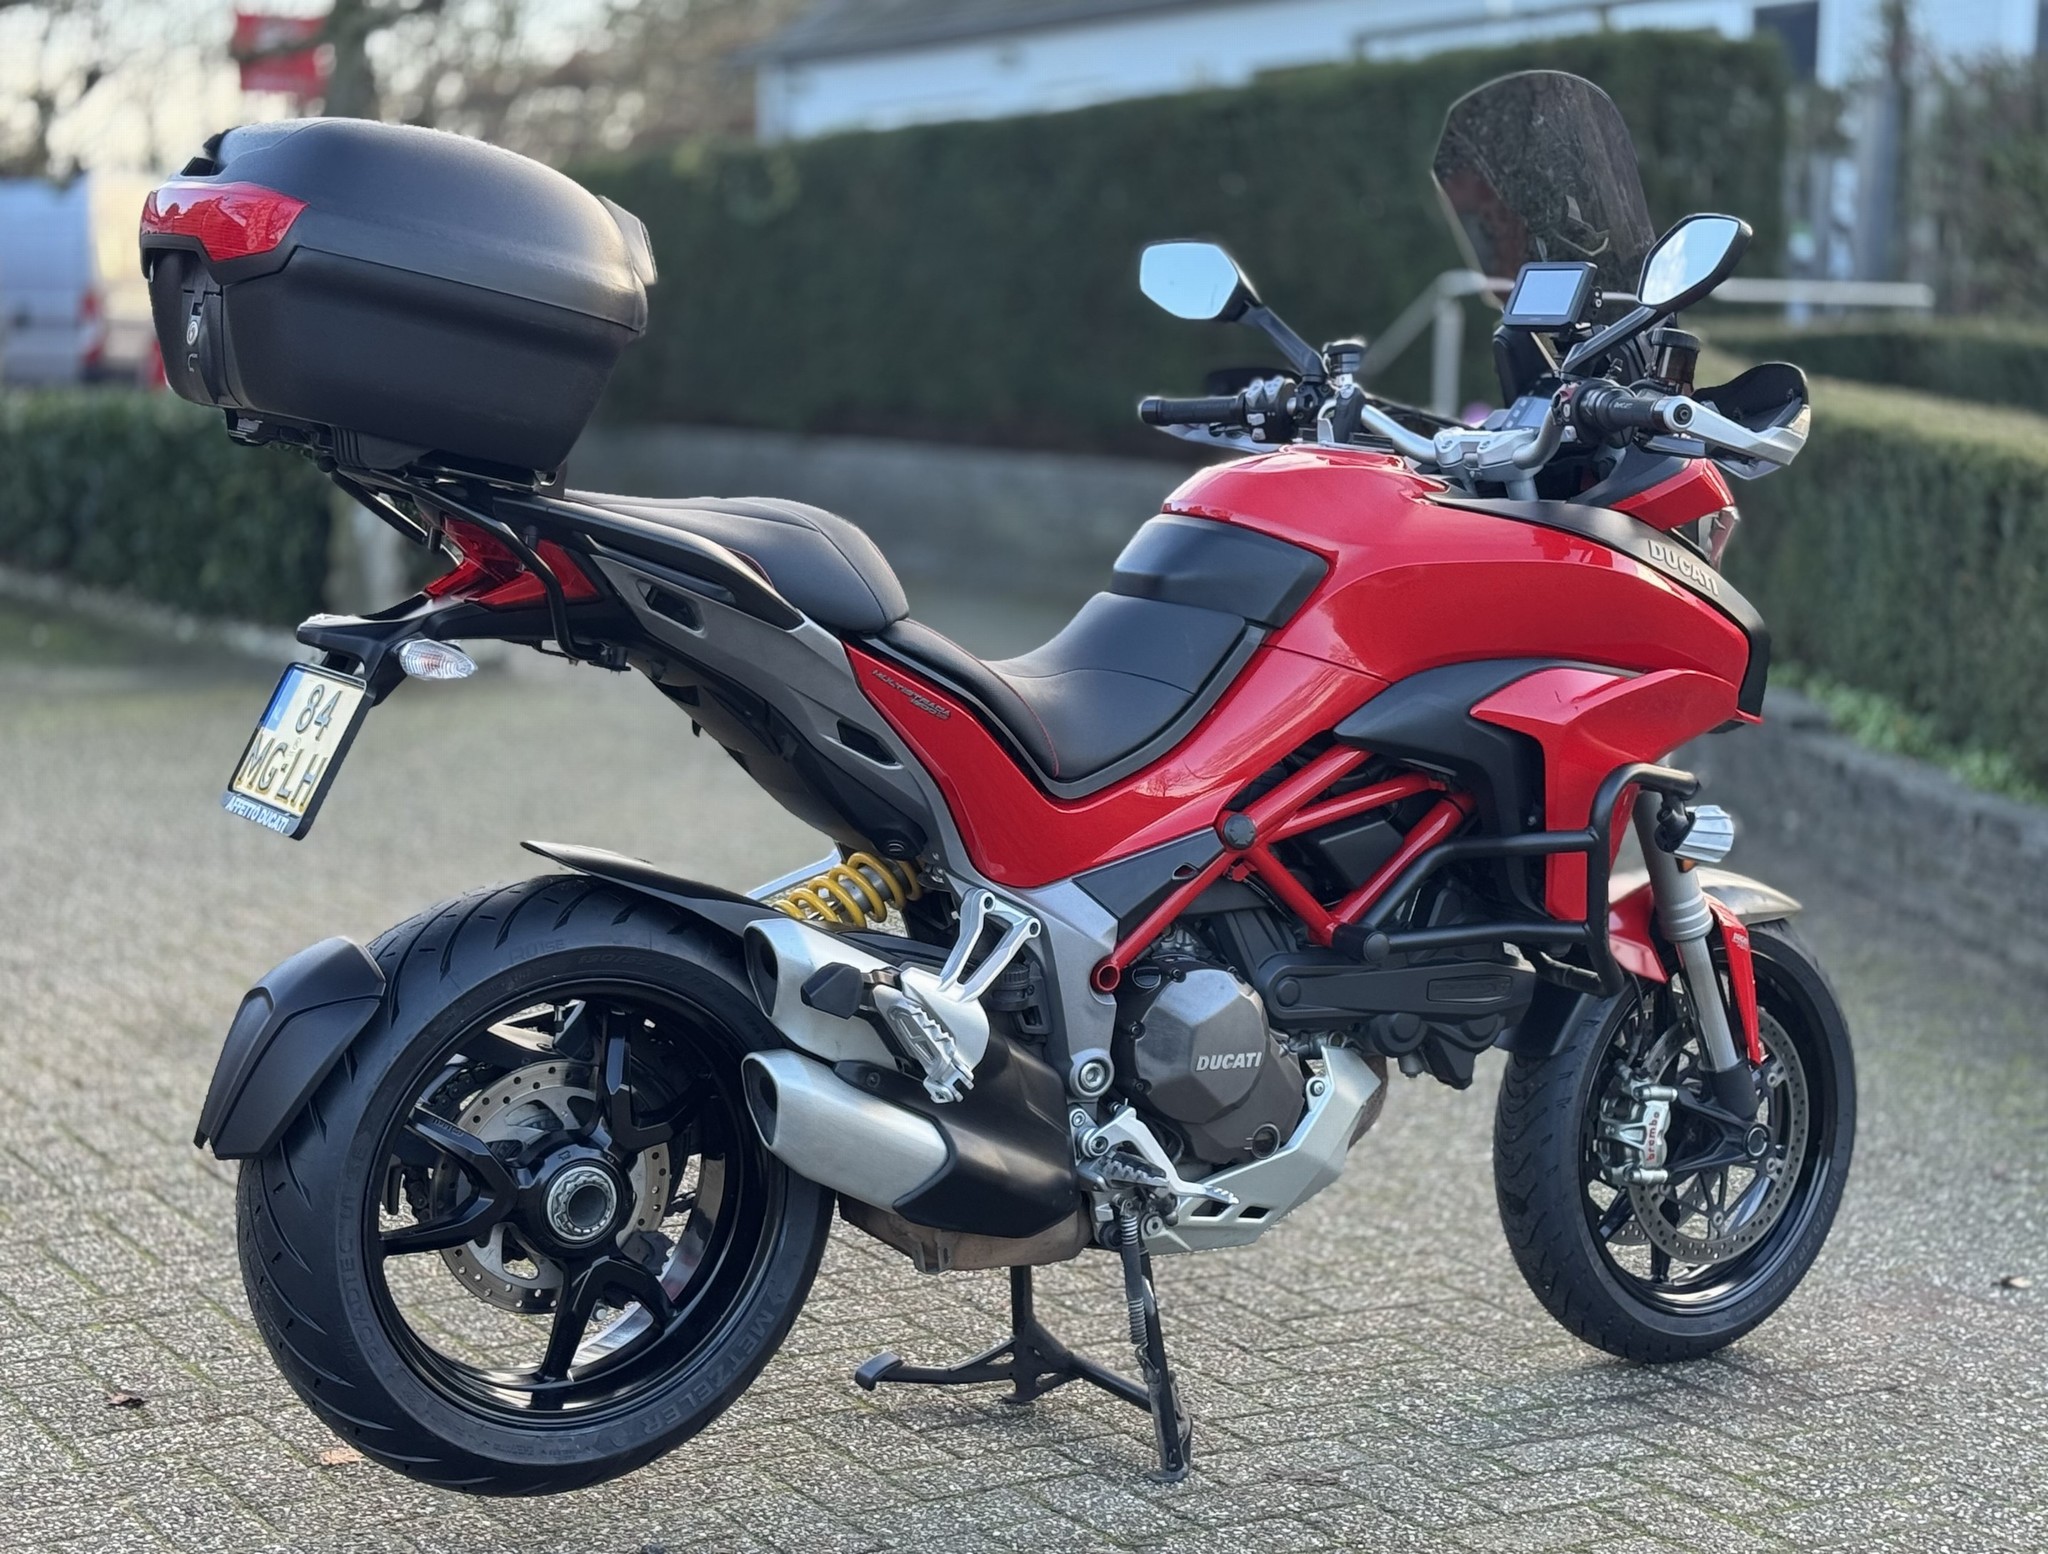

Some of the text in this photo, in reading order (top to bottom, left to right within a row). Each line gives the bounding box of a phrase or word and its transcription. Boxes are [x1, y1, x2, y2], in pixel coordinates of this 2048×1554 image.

[1648, 539, 1719, 597] DUCATI
[295, 683, 343, 742] 84
[225, 795, 290, 834] AFFETTO DUCATI
[1195, 1052, 1262, 1072] DUCATI
[1647, 1111, 1660, 1163] brembo
[643, 1310, 775, 1435] METZELER
